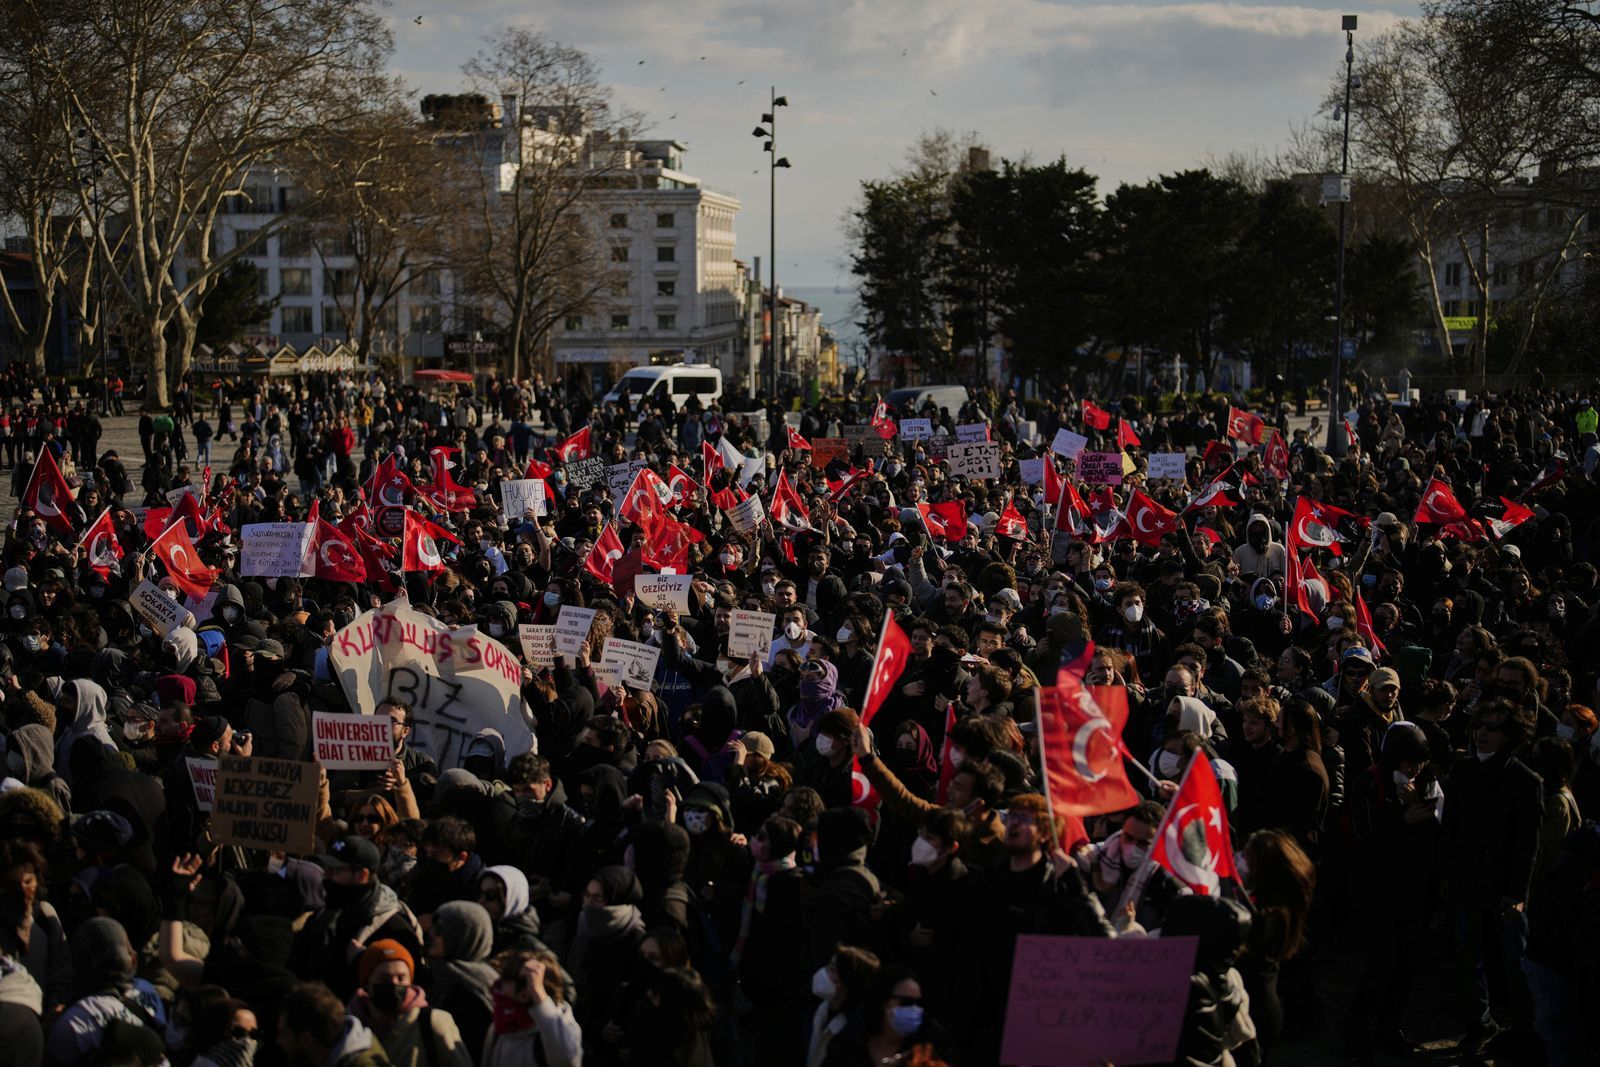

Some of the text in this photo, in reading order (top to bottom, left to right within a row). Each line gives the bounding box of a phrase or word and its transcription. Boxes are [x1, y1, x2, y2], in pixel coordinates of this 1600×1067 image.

[951, 445, 998, 458] L'ETAT
[967, 465, 992, 475] MOI
[641, 582, 683, 593] GEZİCİYİZ
[139, 590, 177, 622] SOKAKTA
[388, 666, 467, 724] BİZ
[316, 717, 389, 743] ÜNİVERSİTE
[318, 741, 392, 762] BİAT ETMEZ!
[224, 778, 295, 800] BENZEMEZ
[232, 819, 289, 844] KORKUSU
[1020, 939, 1081, 965] DÜN
[1034, 1003, 1099, 1029] OLUR
